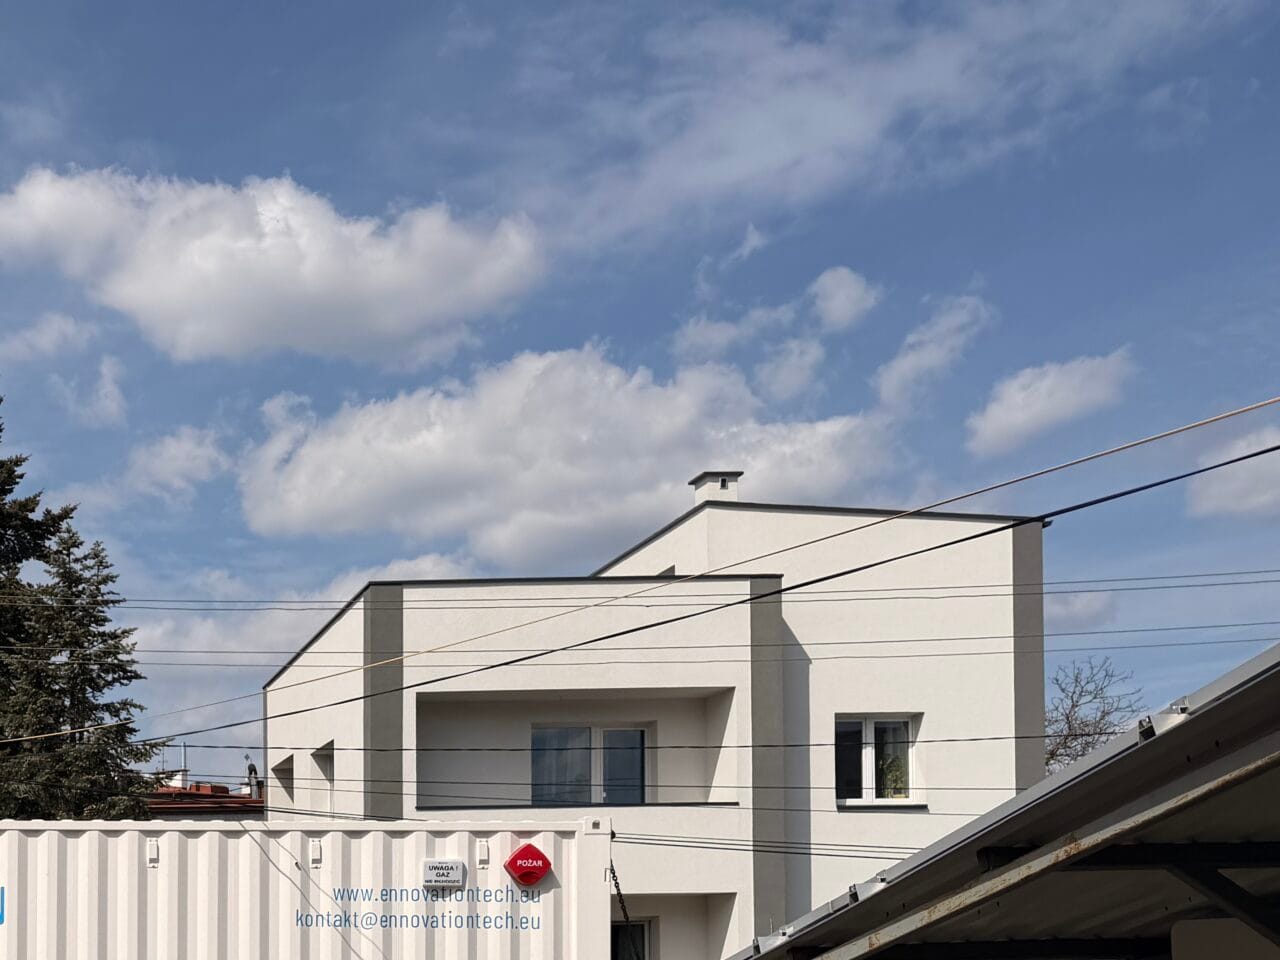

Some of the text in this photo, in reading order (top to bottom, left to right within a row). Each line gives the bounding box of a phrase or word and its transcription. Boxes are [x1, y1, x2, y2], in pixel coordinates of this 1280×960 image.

[516, 858, 543, 867] POŻAR
[332, 883, 541, 904] www.ennovationtech.eu
[295, 909, 541, 930] kontakt@ennovationtech.eu
